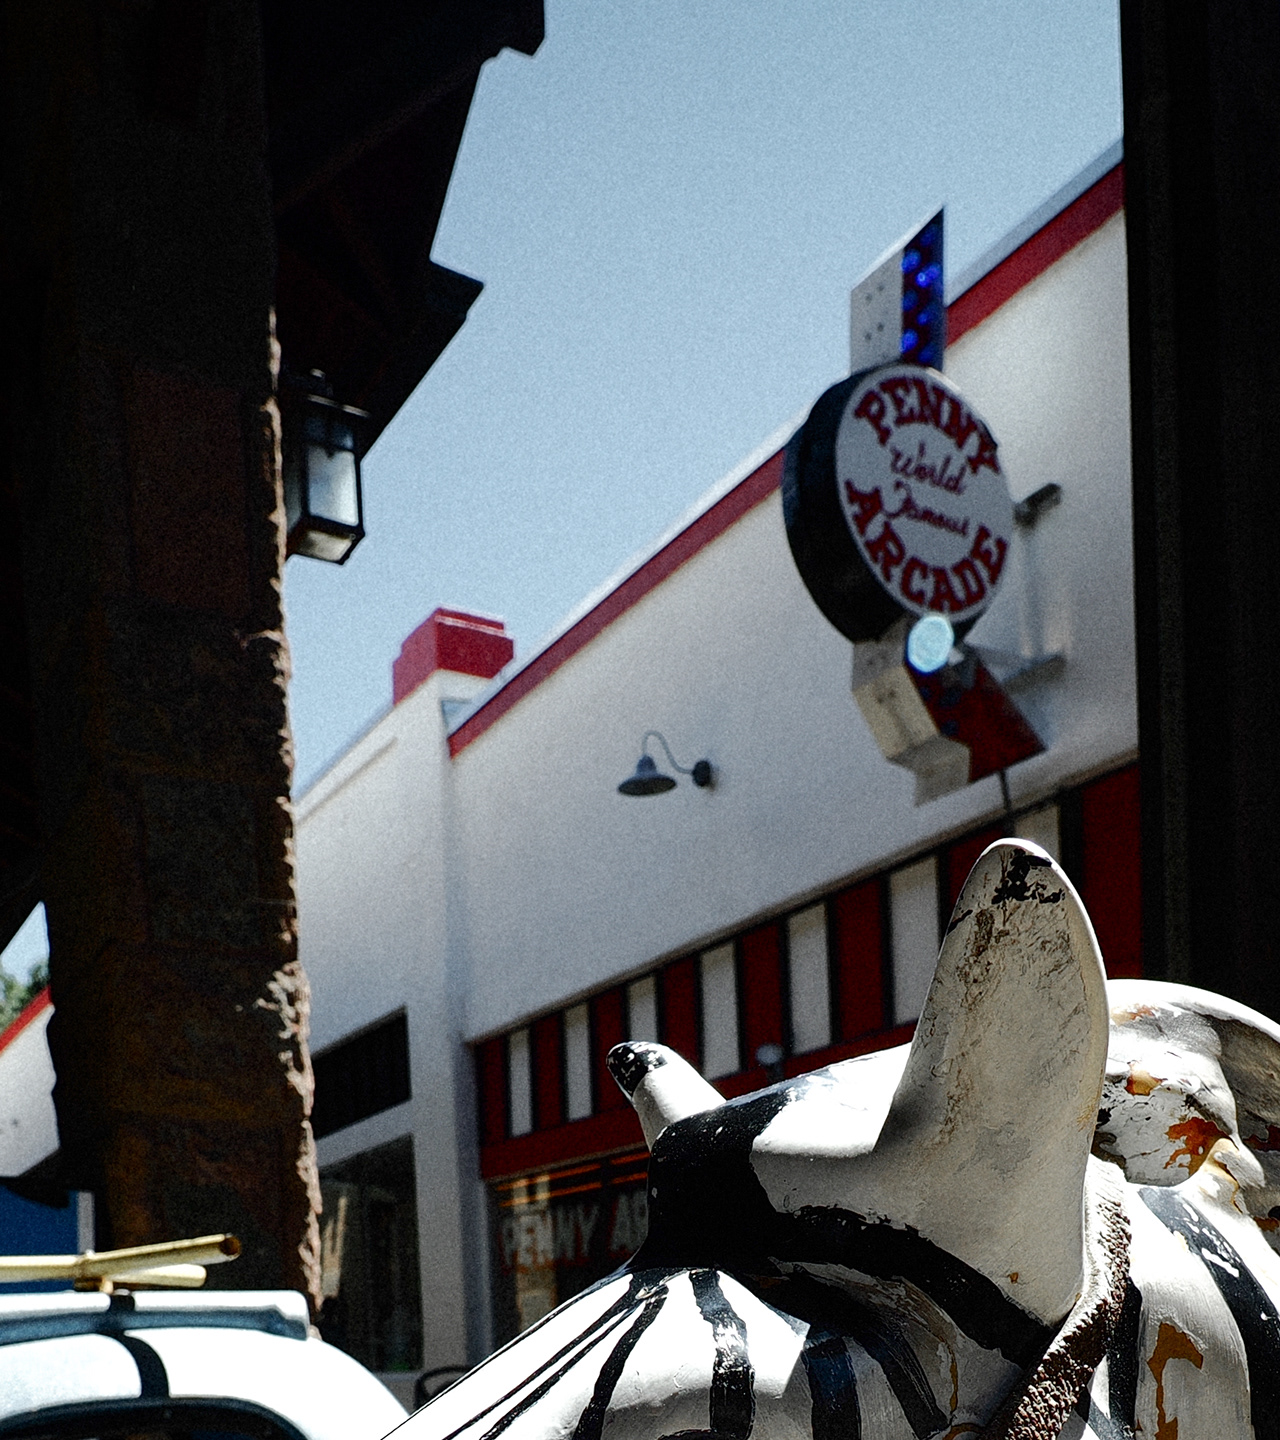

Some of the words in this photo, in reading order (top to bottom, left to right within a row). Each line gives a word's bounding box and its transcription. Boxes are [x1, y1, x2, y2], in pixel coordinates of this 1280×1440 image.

[854, 376, 1000, 474] PENNY
[890, 441, 967, 496] World
[882, 480, 970, 536] Famous
[844, 479, 1008, 613] ARCADE
[496, 1202, 600, 1274] PENNY
